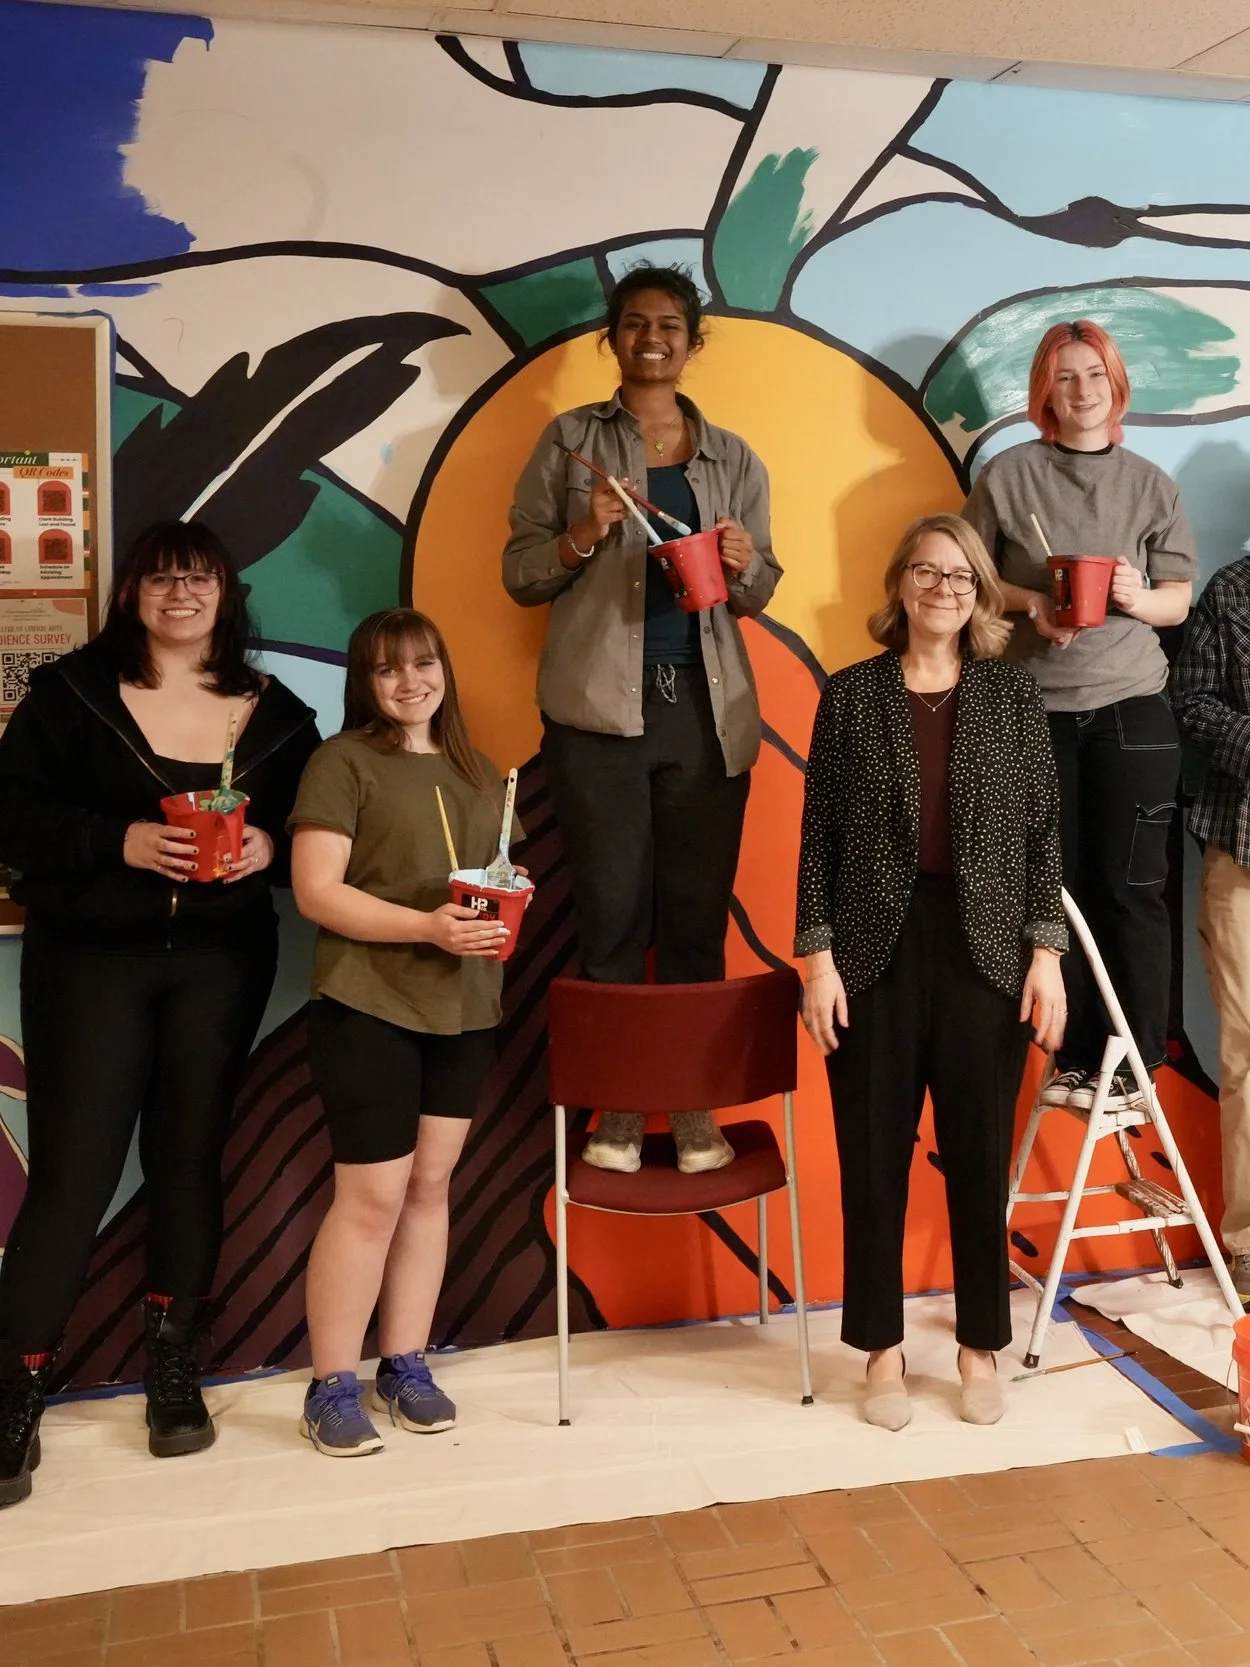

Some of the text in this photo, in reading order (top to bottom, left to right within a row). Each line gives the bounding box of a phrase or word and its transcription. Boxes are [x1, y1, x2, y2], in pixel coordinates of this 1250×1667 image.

[20, 467, 69, 478] QR Codes
[34, 633, 72, 645] SURVEY
